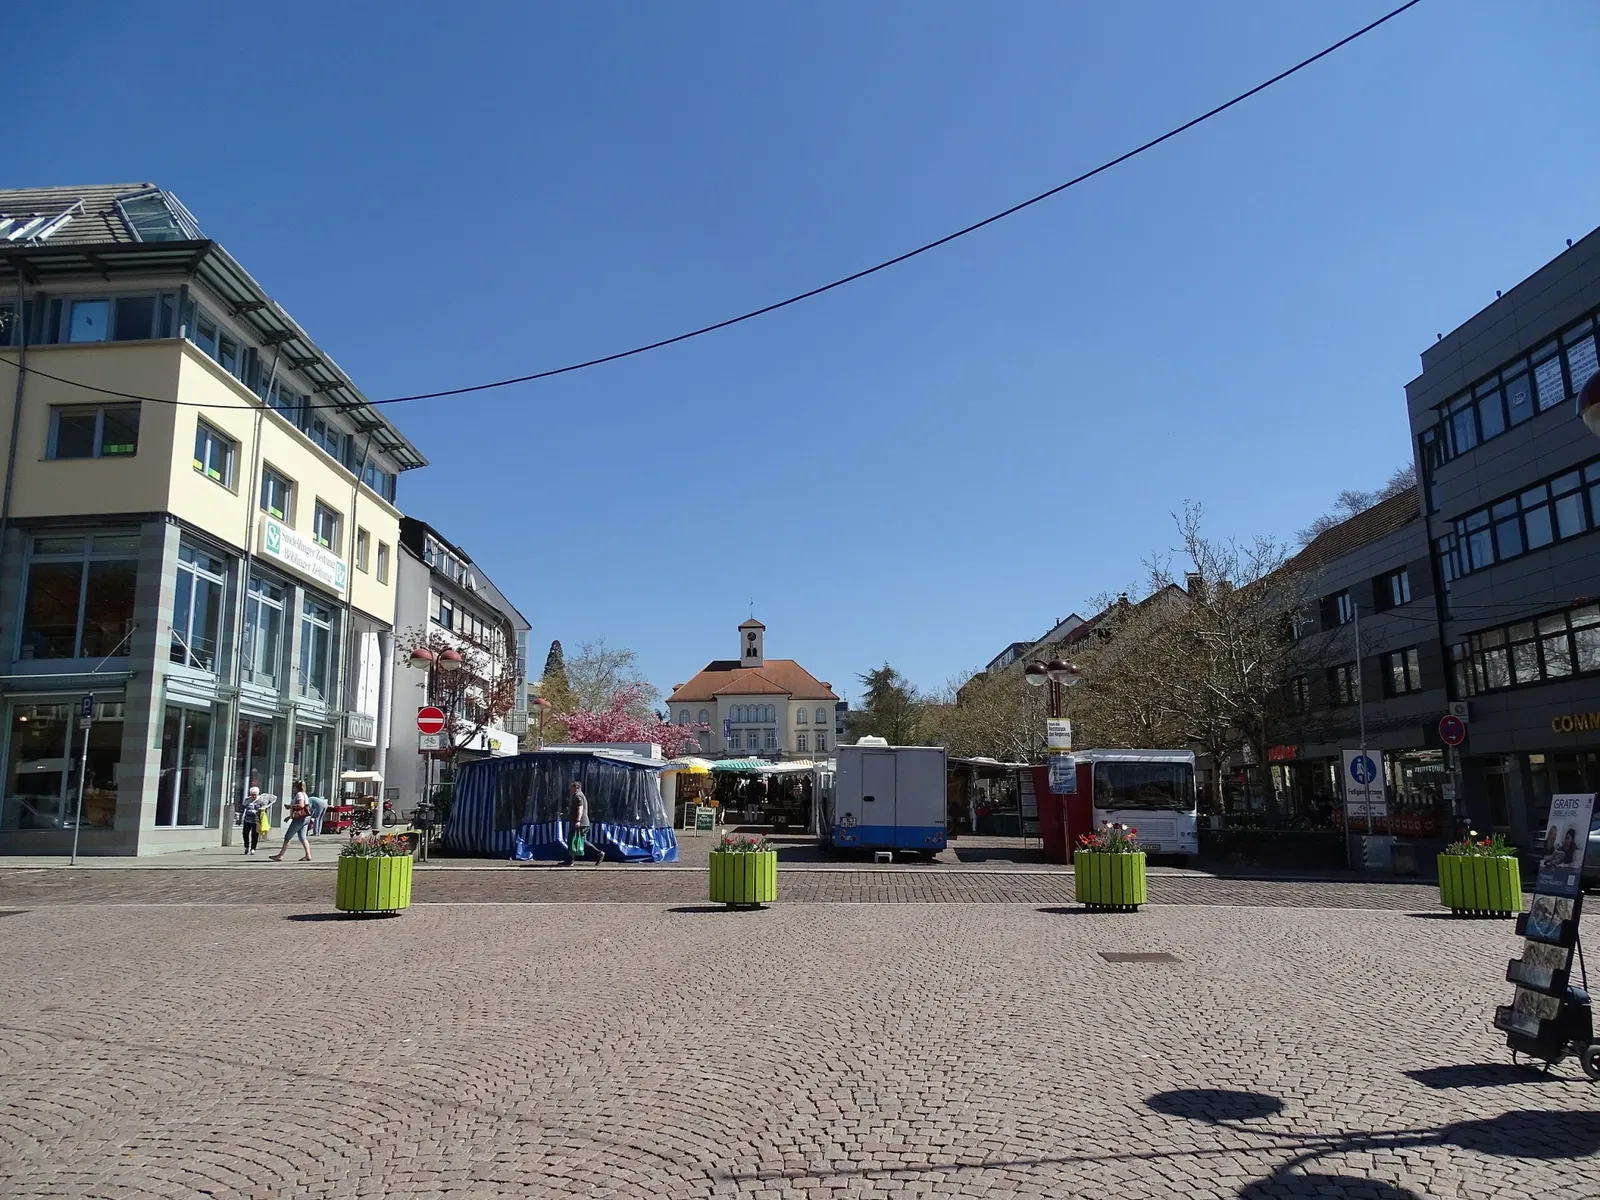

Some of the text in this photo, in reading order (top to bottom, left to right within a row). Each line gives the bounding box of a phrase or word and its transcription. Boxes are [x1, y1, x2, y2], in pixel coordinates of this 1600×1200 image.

[281, 529, 336, 569] Sindelfinger Zeitung
[284, 547, 332, 583] Böblinger Zeitung
[83, 698, 91, 714] P
[1553, 798, 1580, 809] GRATIS
